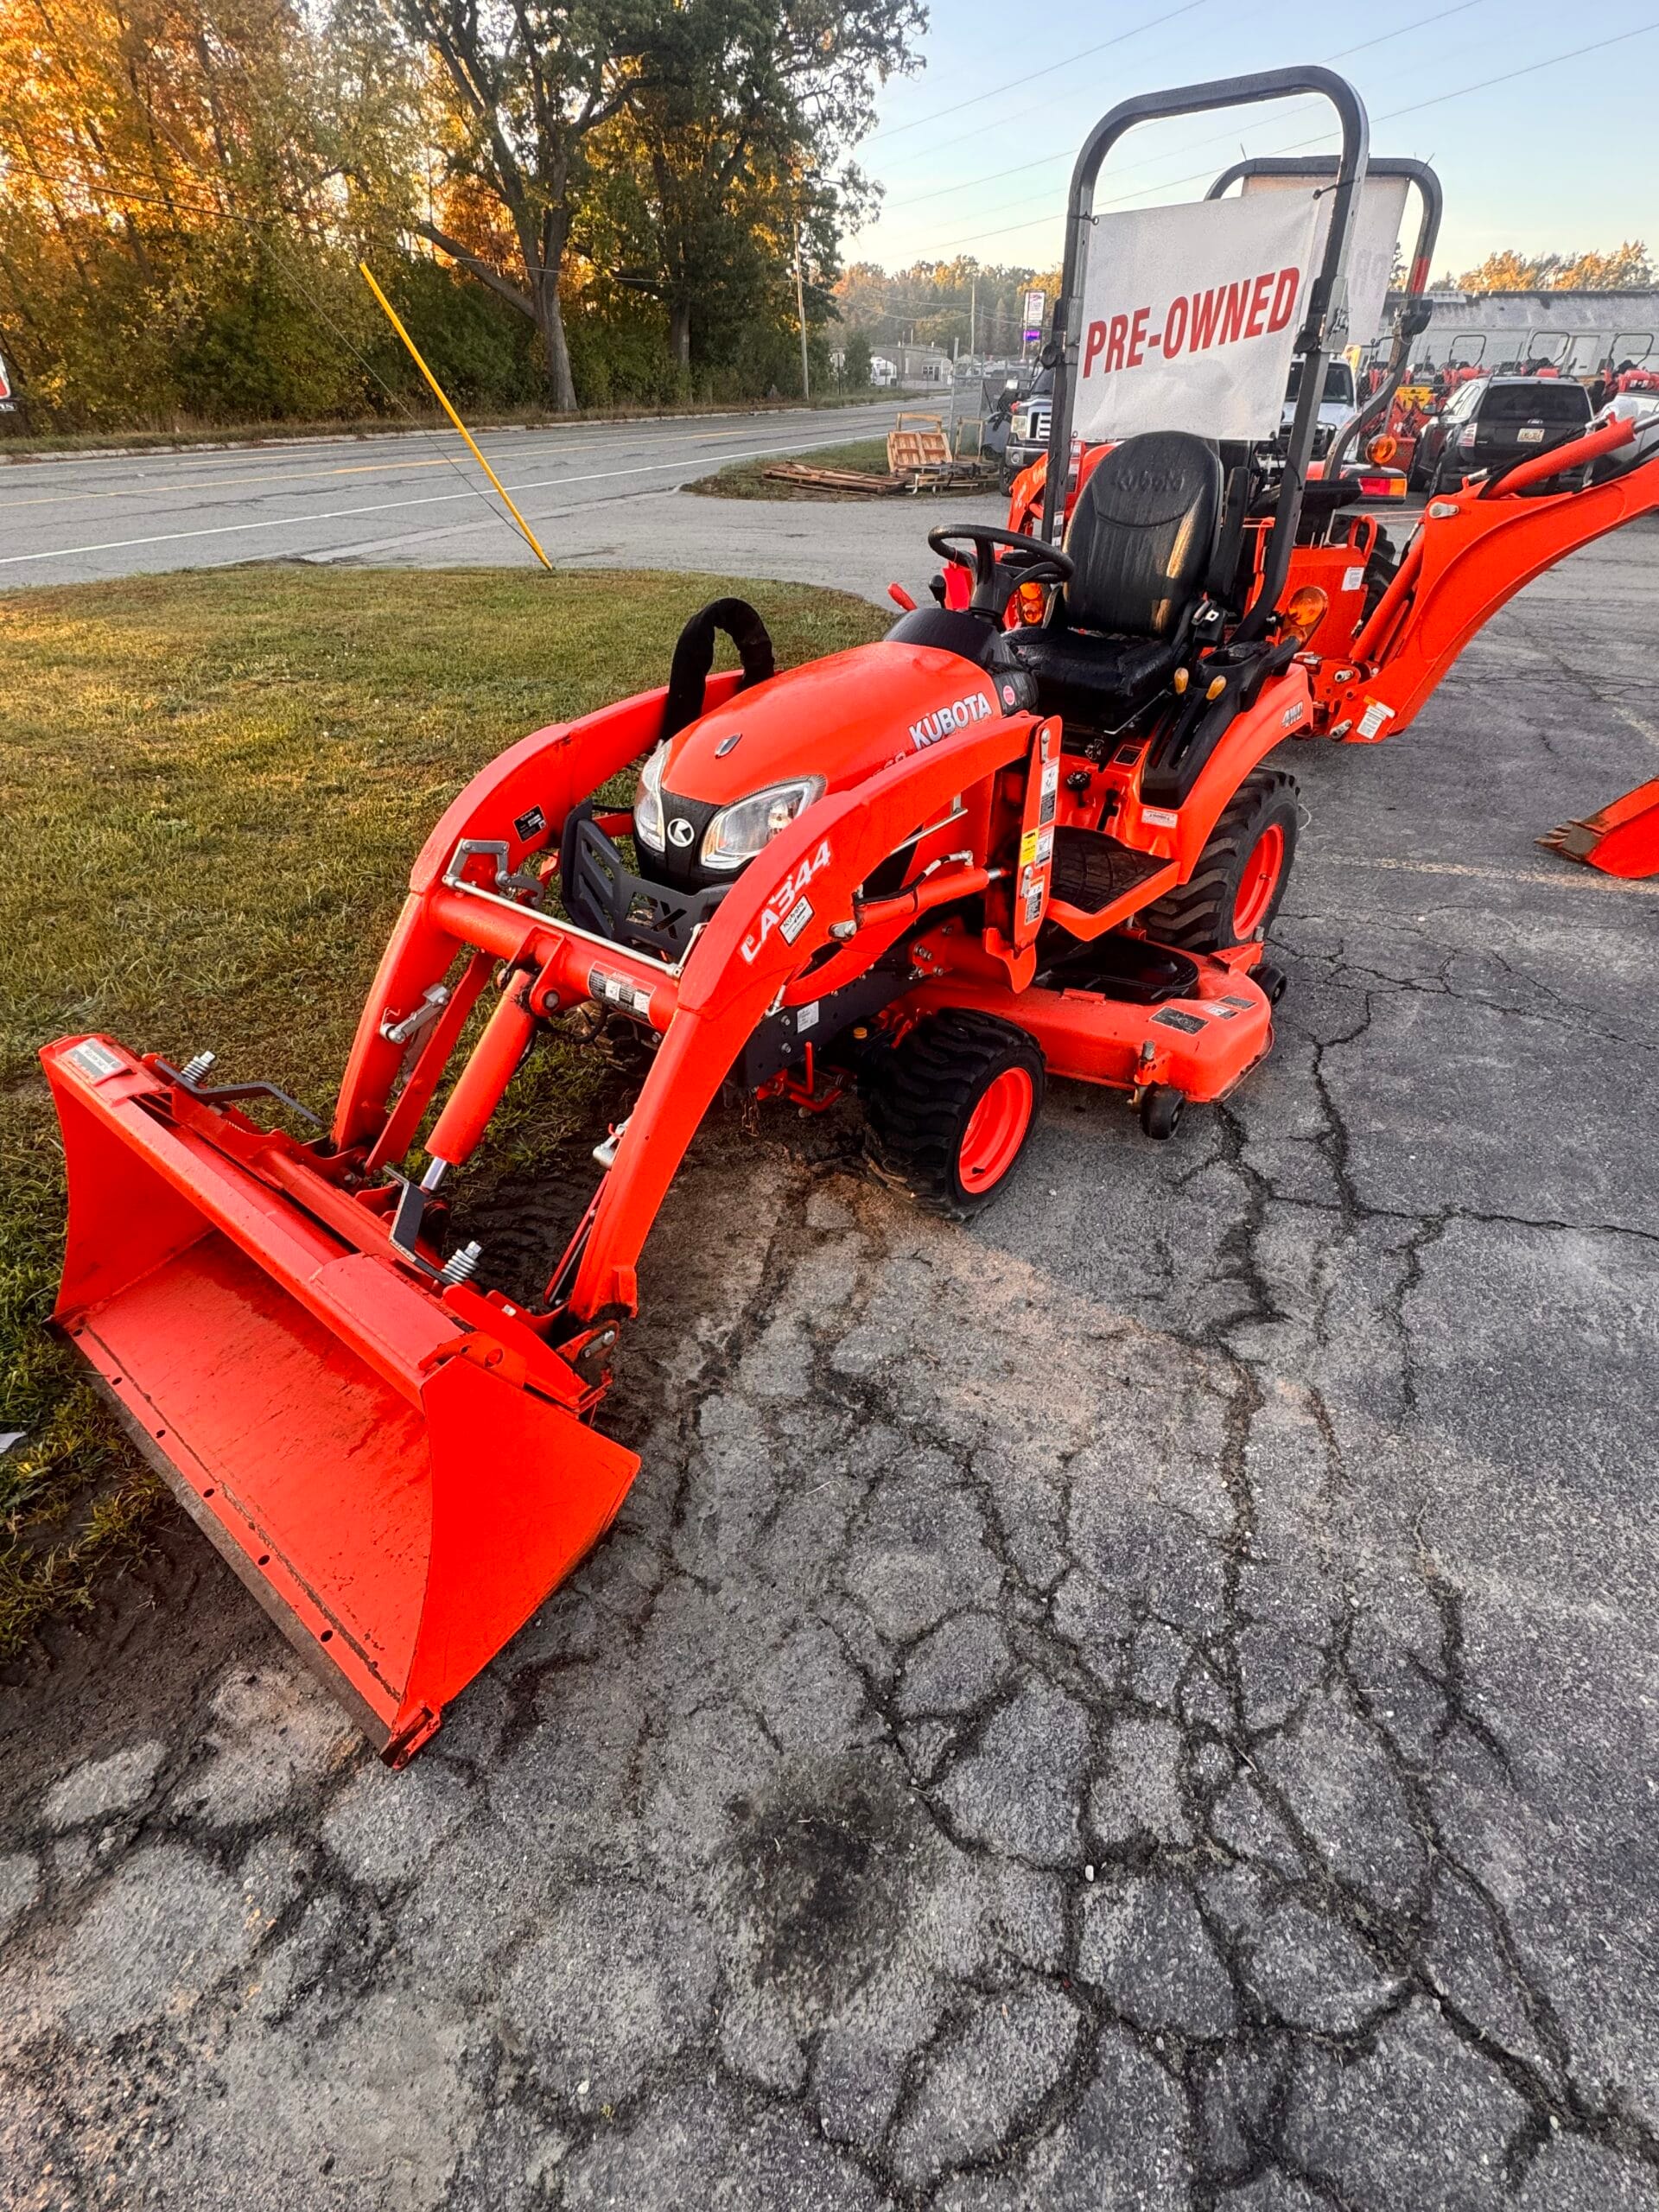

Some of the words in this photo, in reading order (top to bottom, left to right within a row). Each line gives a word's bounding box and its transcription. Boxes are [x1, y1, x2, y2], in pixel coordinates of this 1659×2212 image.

[1083, 267, 1300, 378] PRE-OWNED
[909, 692, 992, 751] KUBOTA
[1281, 701, 1303, 728] 4WD
[741, 840, 831, 963] LA344
